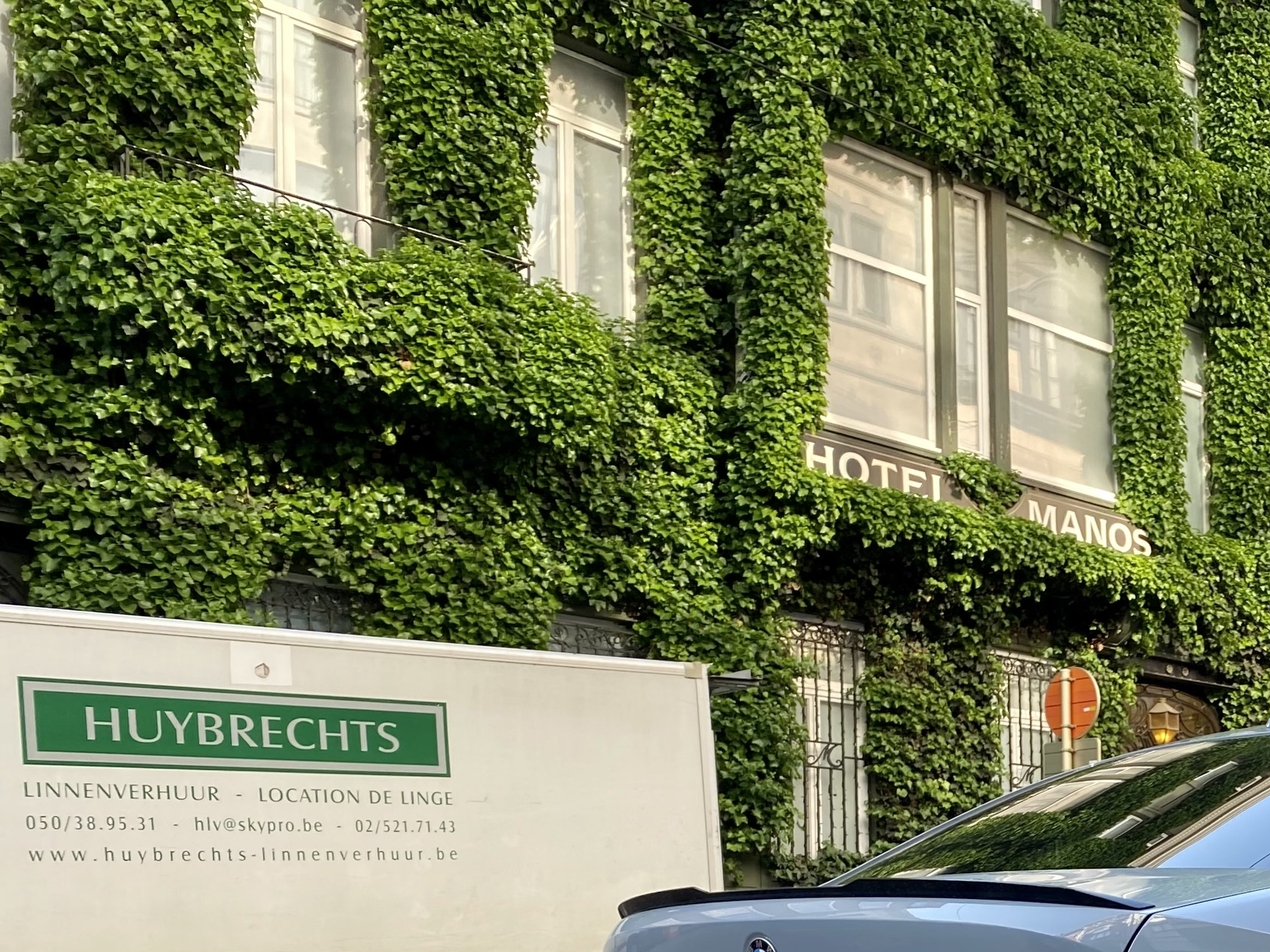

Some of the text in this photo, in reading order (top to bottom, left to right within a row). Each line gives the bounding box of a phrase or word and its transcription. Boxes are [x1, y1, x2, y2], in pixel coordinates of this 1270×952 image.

[1028, 500, 1152, 556] MANOS
[84, 705, 401, 754] HUYBRECHTS
[23, 780, 220, 802] LINNENVERHUUR
[258, 786, 361, 804] LOCATION
[369, 789, 393, 805] DE
[400, 790, 454, 806] LINGE
[25, 814, 156, 832] 050/38.95.31
[194, 816, 323, 835] hlv@skypro.be
[355, 818, 456, 835] 02/521.71.43
[28, 846, 459, 866] www.huybrechts-linnenverhuur.be
